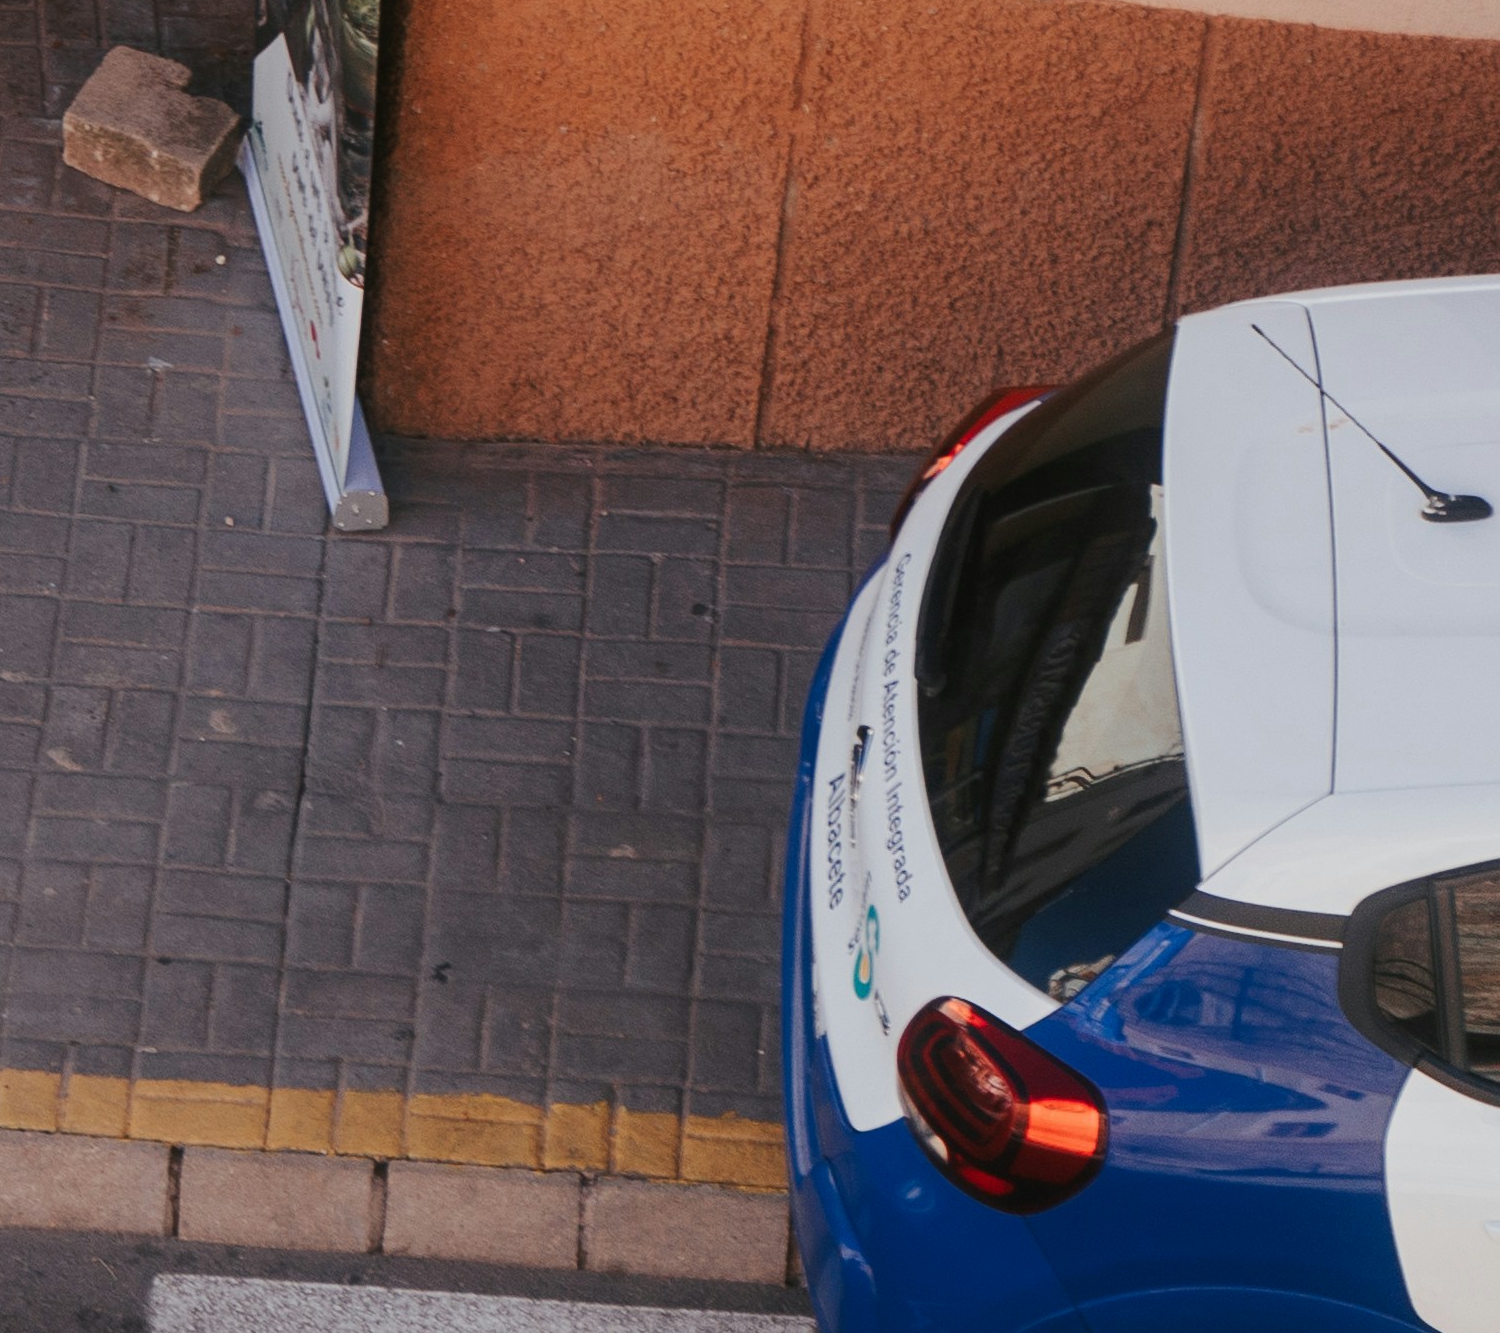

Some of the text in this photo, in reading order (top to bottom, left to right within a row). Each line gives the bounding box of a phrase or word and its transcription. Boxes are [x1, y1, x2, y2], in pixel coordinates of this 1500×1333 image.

[826, 773, 847, 910] Albacete
[880, 552, 913, 903] Gerencia de Atención Integrada
